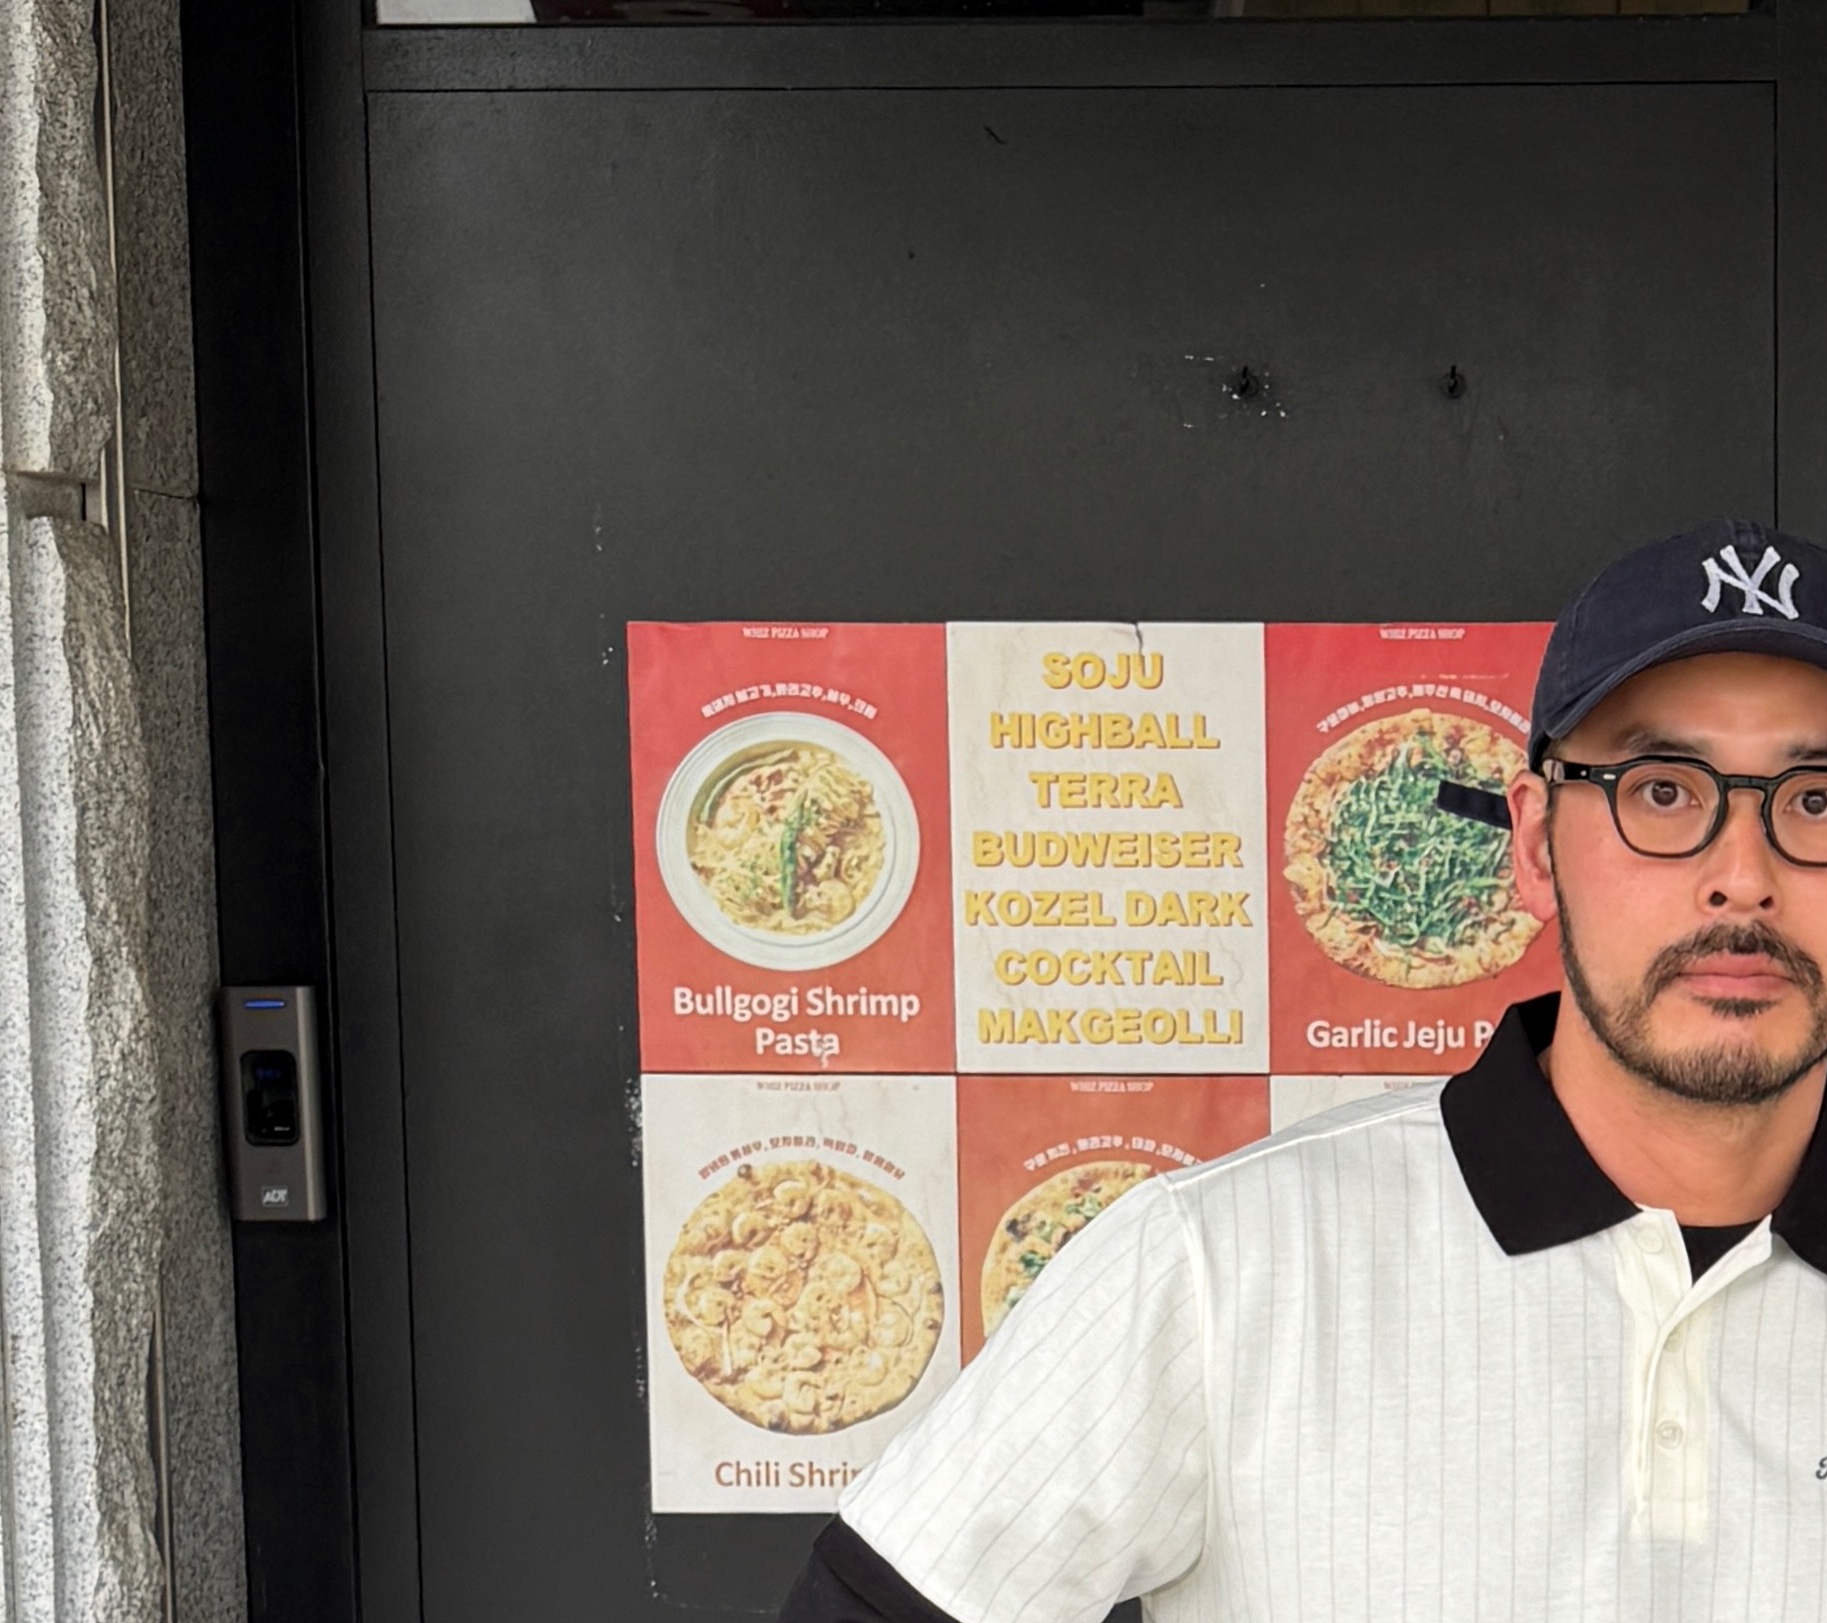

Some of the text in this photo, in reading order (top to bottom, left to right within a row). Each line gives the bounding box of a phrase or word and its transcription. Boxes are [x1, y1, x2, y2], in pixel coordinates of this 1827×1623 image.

[1042, 651, 1163, 690] SOJU
[989, 711, 1220, 751] HIGHBALL
[1030, 771, 1184, 810] TERRA
[973, 831, 1242, 870] BUDWEISER
[965, 891, 1252, 929] KOZEL DARK
[996, 949, 1223, 988] COCKTAIL
[673, 987, 921, 1024] Bullgogi Shrimp
[755, 1026, 838, 1058] Pasta
[977, 1008, 1243, 1047] MAKGEOLLI
[1306, 1018, 1494, 1057] Garlic Jeju P
[714, 1461, 862, 1488] Chili Shri
